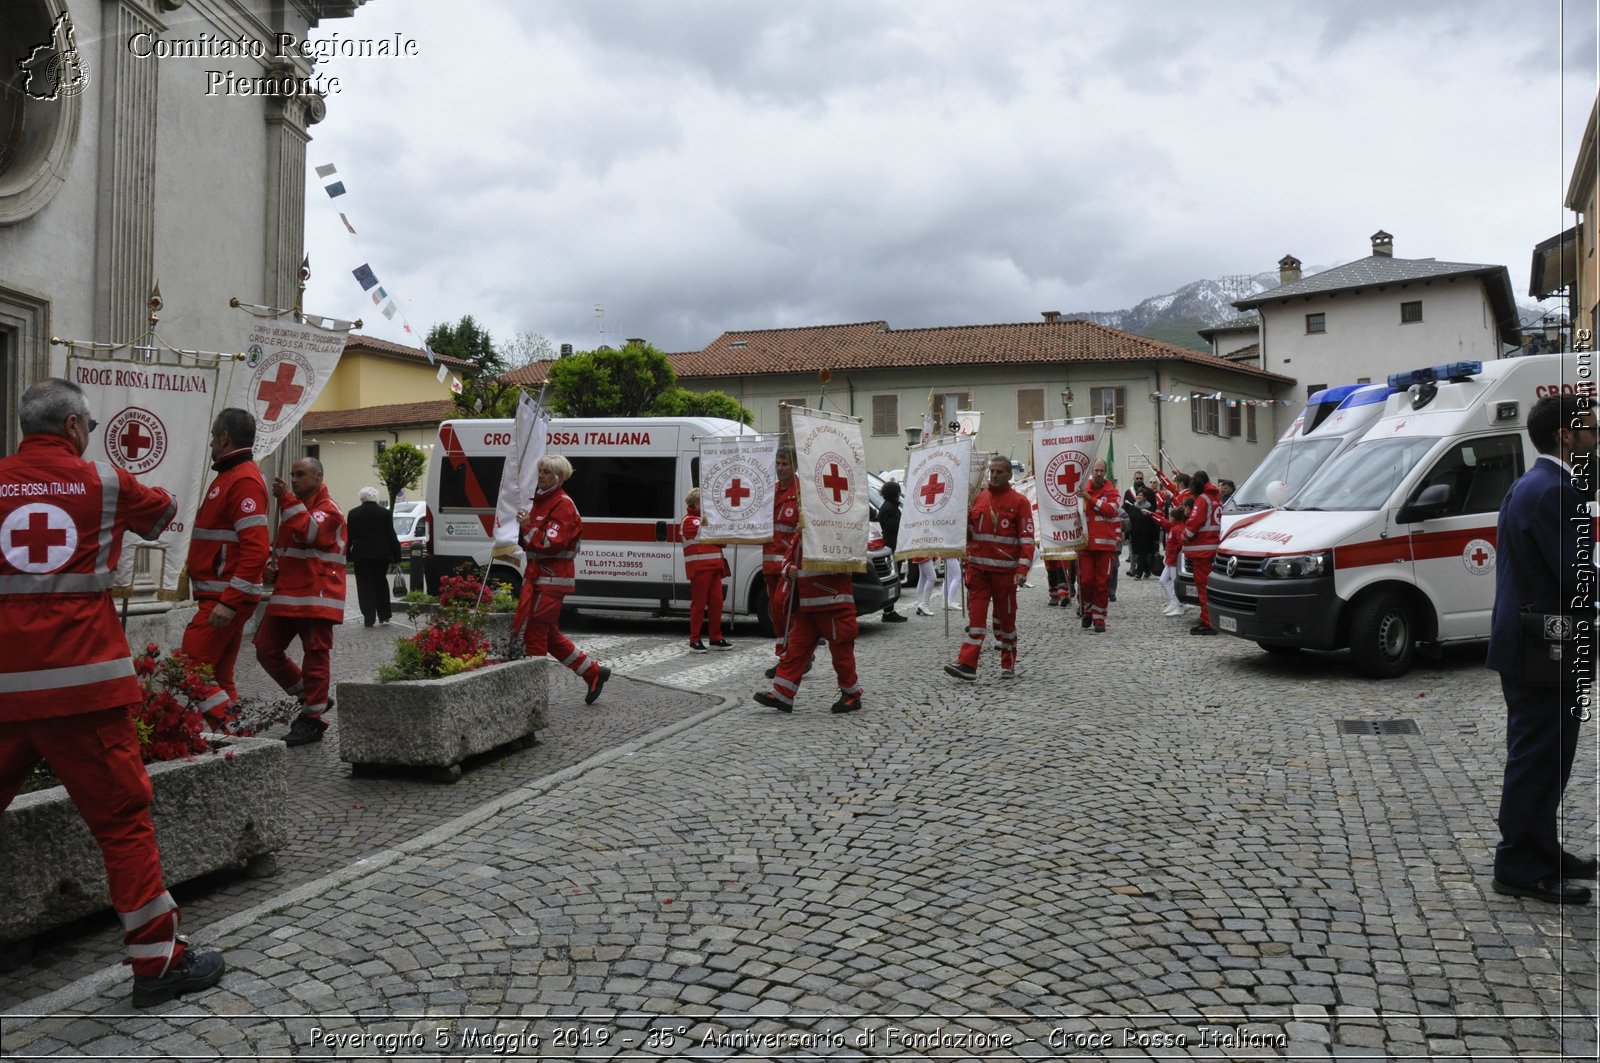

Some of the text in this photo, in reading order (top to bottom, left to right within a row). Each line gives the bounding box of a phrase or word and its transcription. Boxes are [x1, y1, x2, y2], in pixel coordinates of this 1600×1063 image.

[276, 338, 304, 351] ROSSA
[305, 341, 341, 354] ITALIANA
[76, 366, 207, 393] CROCE ROSSA ITALIANA
[117, 417, 126, 426] DI
[150, 421, 159, 430] 22
[484, 432, 651, 446] CRO OSSA ITALIANA
[154, 431, 163, 459] AGOSTO
[1046, 452, 1072, 487] CONVENZIONE
[21, 482, 49, 497] ROSSA
[50, 482, 86, 496] ITALIANA
[811, 519, 864, 531] COMITATO LOCALE
[932, 518, 957, 527] LOCALE
[836, 532, 843, 541] DI
[822, 544, 853, 555] BUSCA
[584, 559, 643, 569] TEL.0171.339555
[579, 568, 648, 577] cl.peveragno@cri.it
